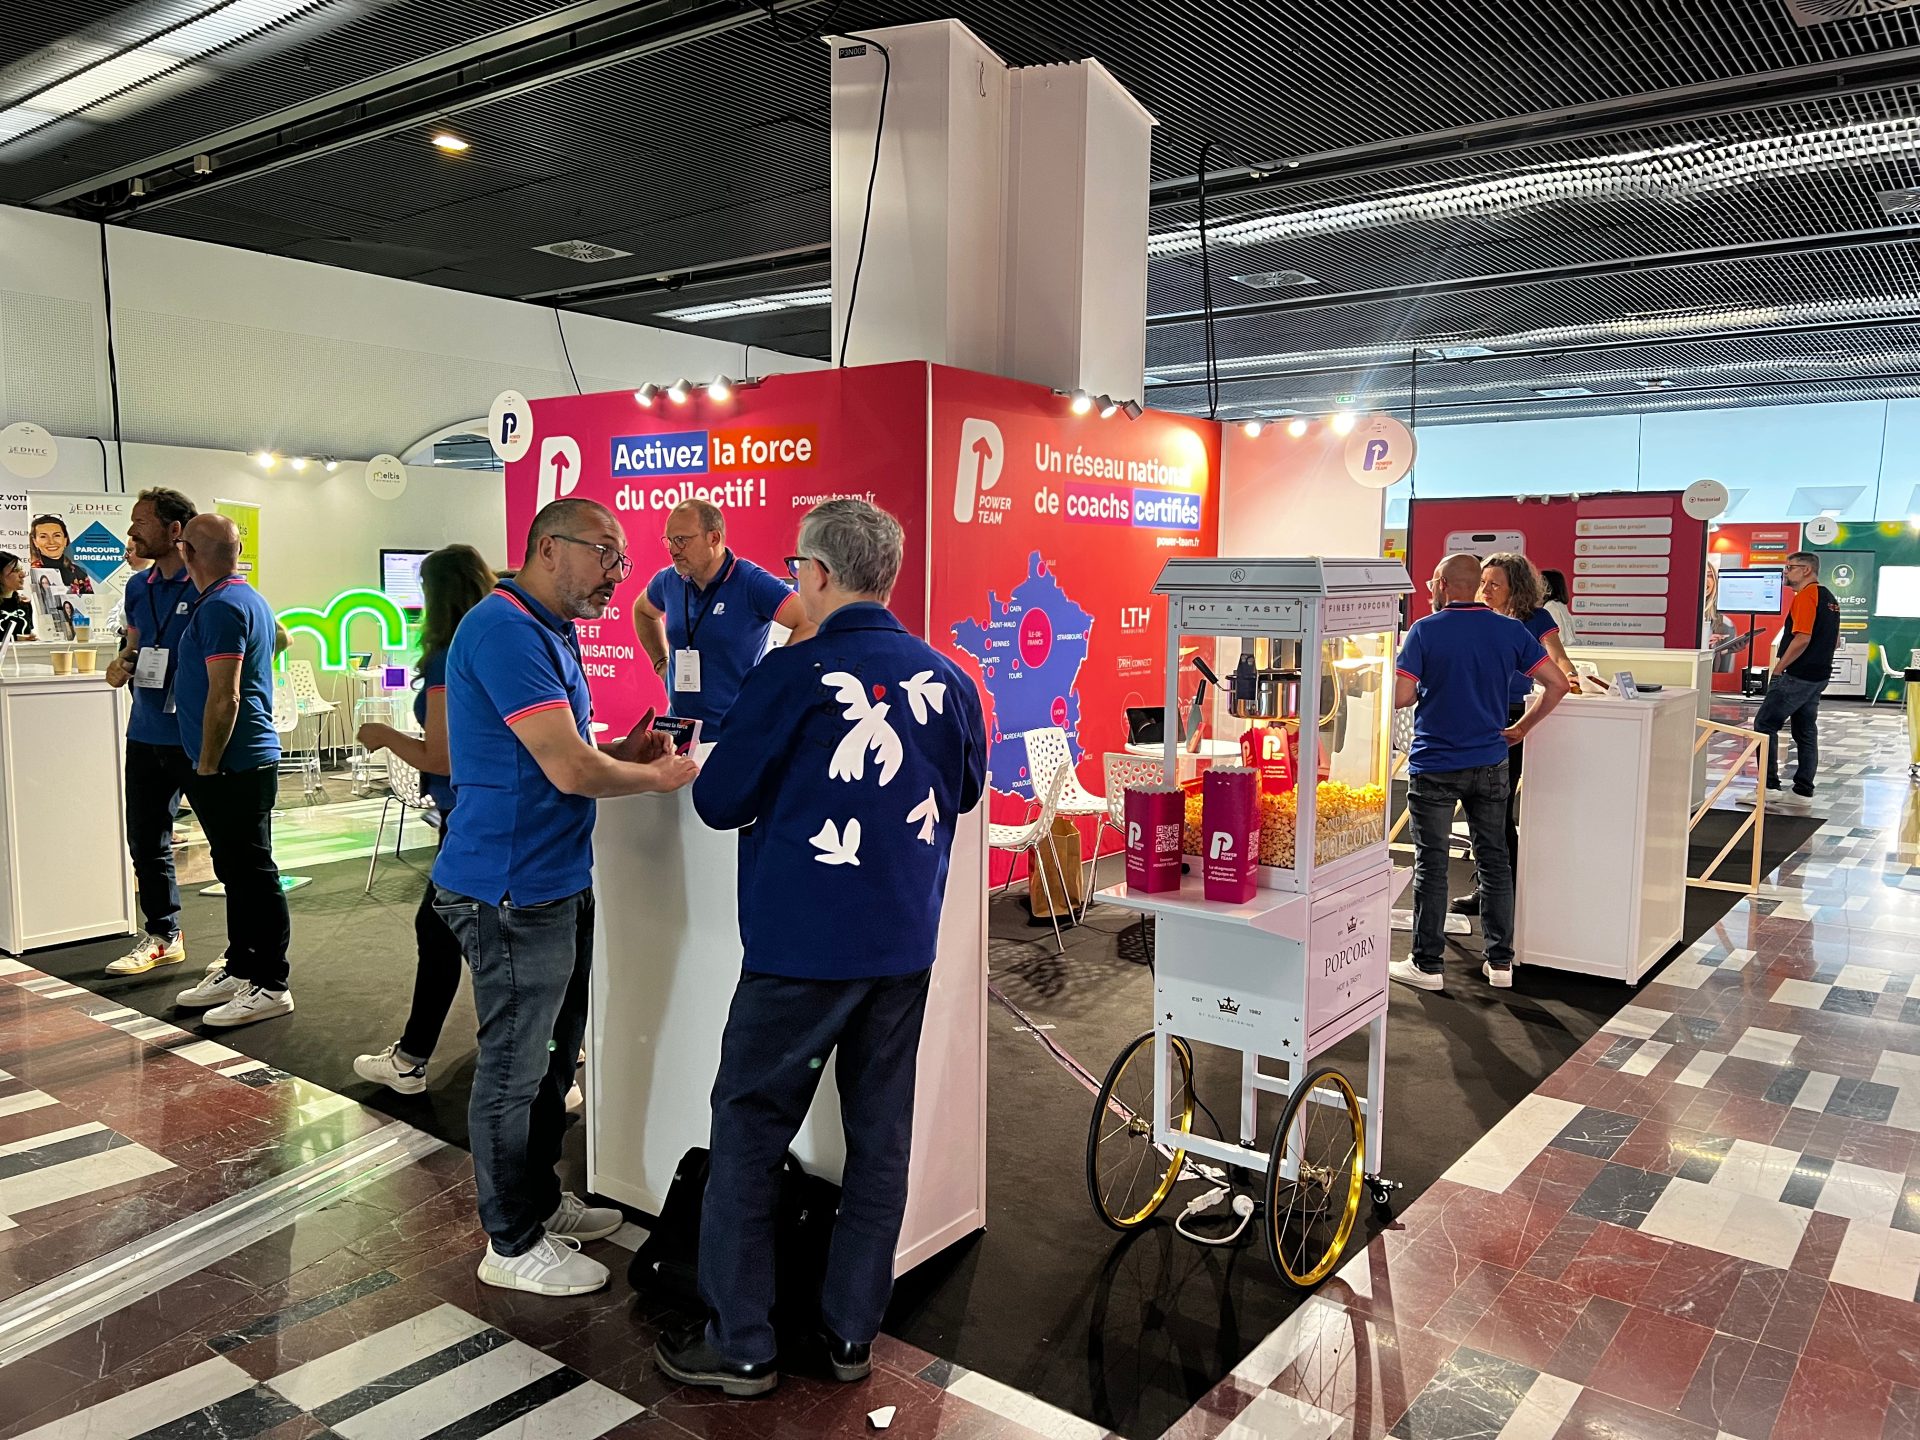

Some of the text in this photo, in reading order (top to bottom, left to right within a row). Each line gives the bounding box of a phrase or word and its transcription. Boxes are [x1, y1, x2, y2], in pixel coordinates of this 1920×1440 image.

[839, 47, 866, 57] P3N005
[614, 435, 812, 471] Activez la force
[1035, 442, 1191, 488] Un réseau national
[615, 478, 766, 511] du collectif !
[792, 490, 876, 508] powerteam.fr
[76, 503, 123, 512] EDHEC
[979, 495, 1012, 510] POWER
[1034, 486, 1198, 525] de coachs certifiés
[978, 510, 1002, 525] TEAM
[1156, 536, 1200, 548] power-team.fr
[1010, 605, 1022, 613] CAEN
[1244, 605, 1292, 613] TASTY
[1328, 601, 1391, 613] FINEST POPCORN
[990, 621, 1016, 629] SAINT-MALO
[588, 625, 601, 638] ET
[993, 640, 1010, 648] RENNES
[983, 656, 1000, 664] NANTES
[1009, 672, 1023, 680] TOURS
[1003, 731, 1024, 741] BORDEAU
[1012, 778, 1031, 788] TOULOUS
[1324, 934, 1375, 978] POPCORN
